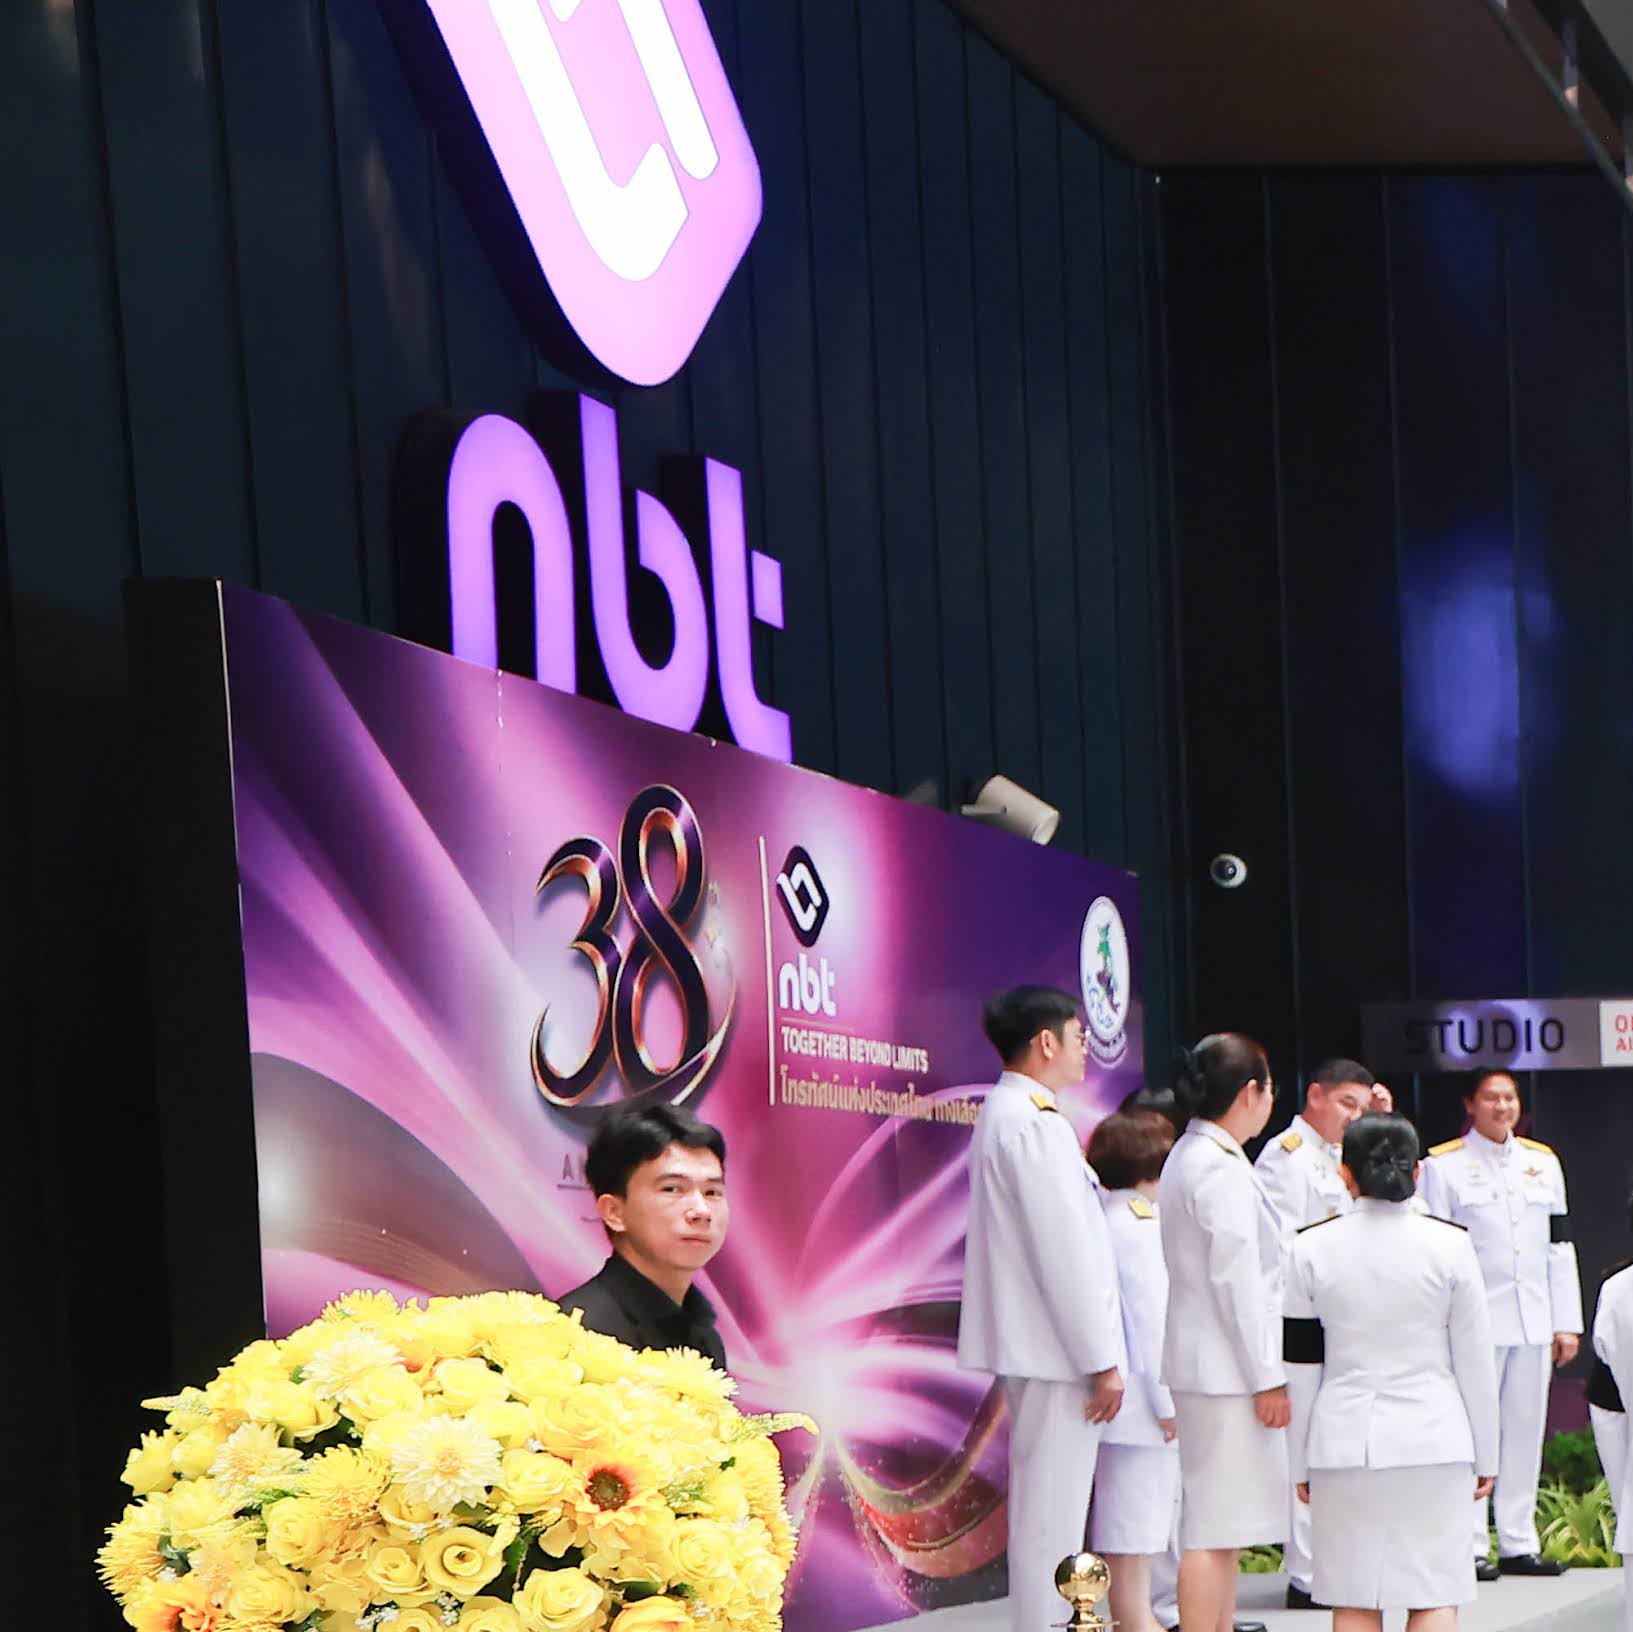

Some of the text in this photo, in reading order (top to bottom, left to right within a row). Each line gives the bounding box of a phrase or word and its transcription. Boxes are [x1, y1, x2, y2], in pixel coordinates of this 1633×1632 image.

[447, 393, 792, 763] nbt
[531, 783, 711, 1106] 38
[779, 953, 837, 1017] nbt
[781, 1026, 929, 1074] TOGETHER BEYOND LIMITS
[1405, 1018, 1565, 1054] STUDIO
